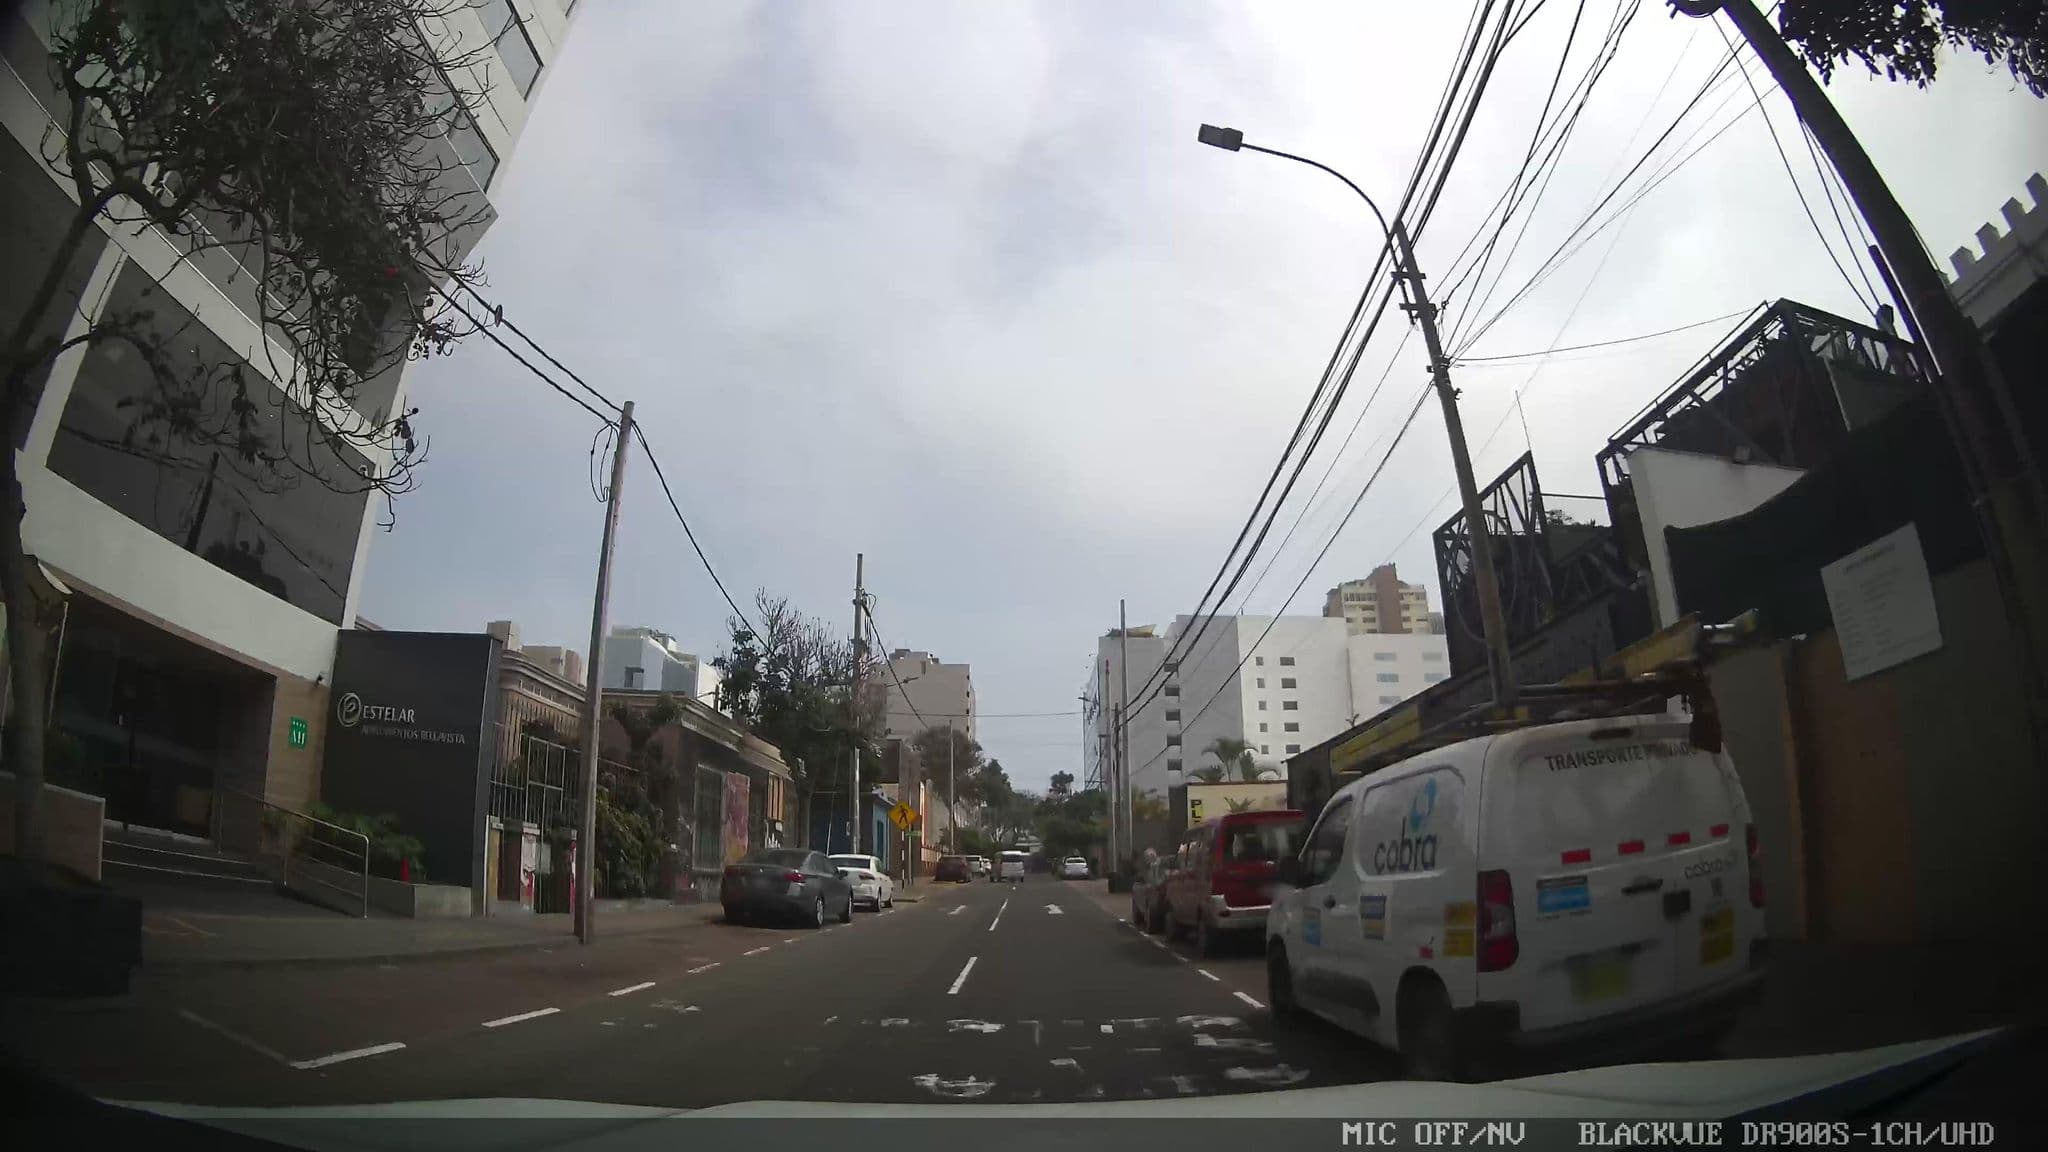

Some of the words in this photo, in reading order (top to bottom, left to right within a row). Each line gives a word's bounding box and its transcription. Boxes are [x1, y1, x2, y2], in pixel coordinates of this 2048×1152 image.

[362, 705, 416, 723] ESTELAR
[1543, 744, 1643, 772] TRANSPORTE
[1374, 815, 1438, 875] cobra
